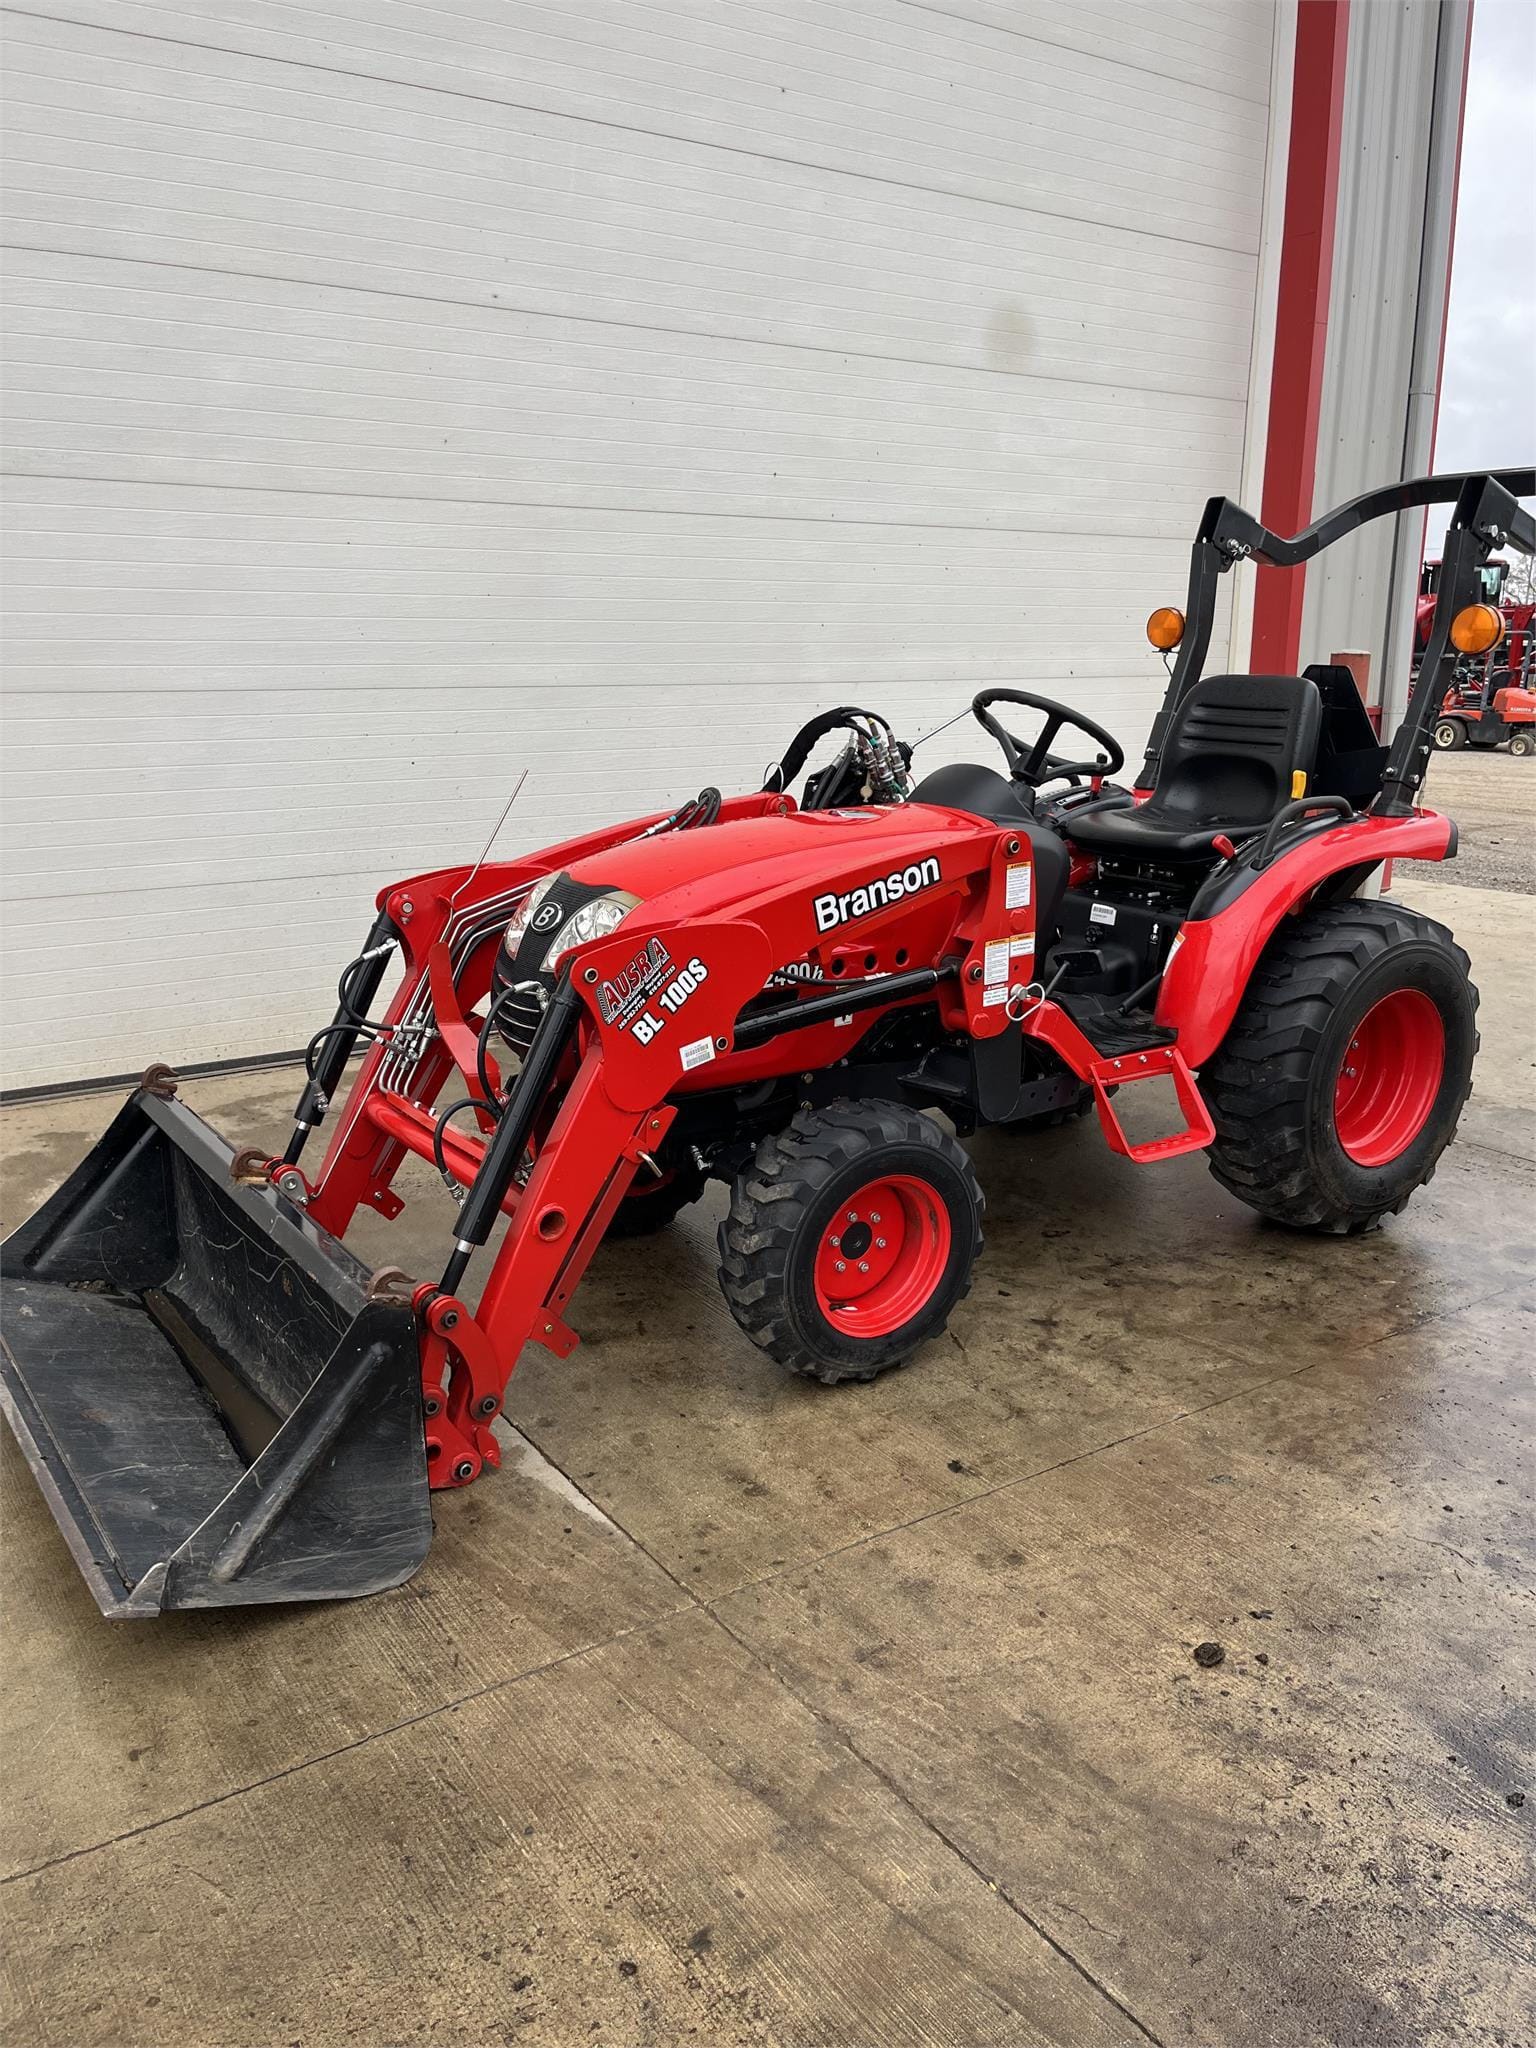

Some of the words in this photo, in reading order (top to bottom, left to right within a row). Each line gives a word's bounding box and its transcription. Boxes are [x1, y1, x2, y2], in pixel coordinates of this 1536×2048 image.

[534, 906, 555, 926] B
[814, 857, 941, 932] Branson
[597, 937, 668, 1019] AUSRA
[631, 1011, 665, 1045] BL
[659, 958, 708, 1013] 100S
